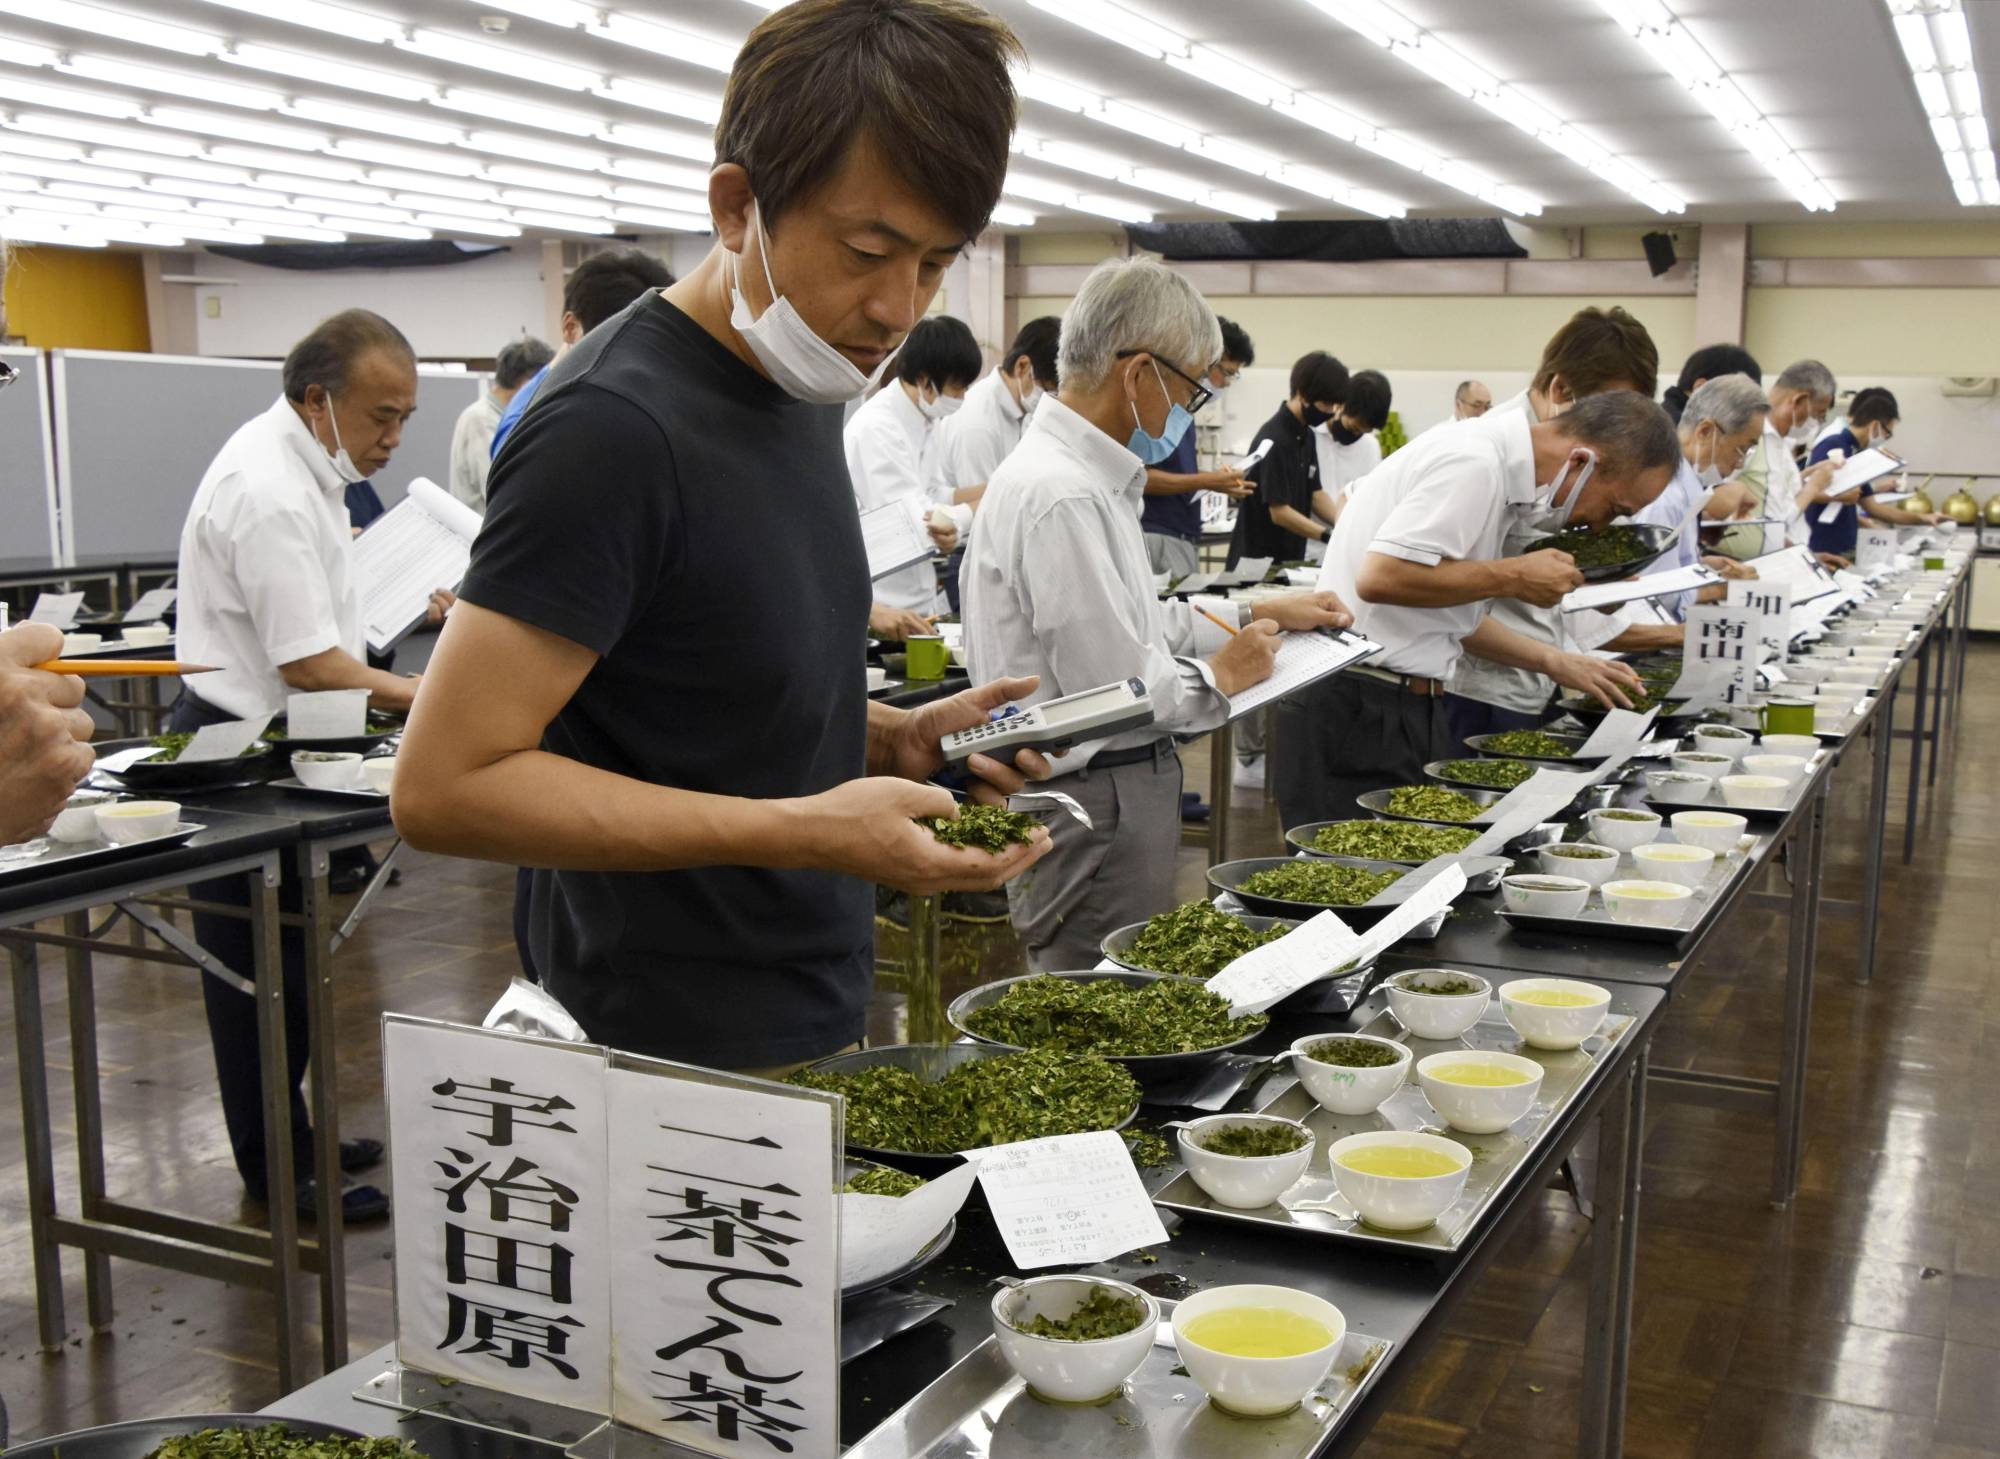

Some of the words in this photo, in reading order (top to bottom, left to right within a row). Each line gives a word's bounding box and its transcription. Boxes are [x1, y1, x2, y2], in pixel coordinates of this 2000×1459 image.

[432, 1077, 586, 1380] 宇治田原
[646, 1124, 808, 1453] 二茶てん茶
